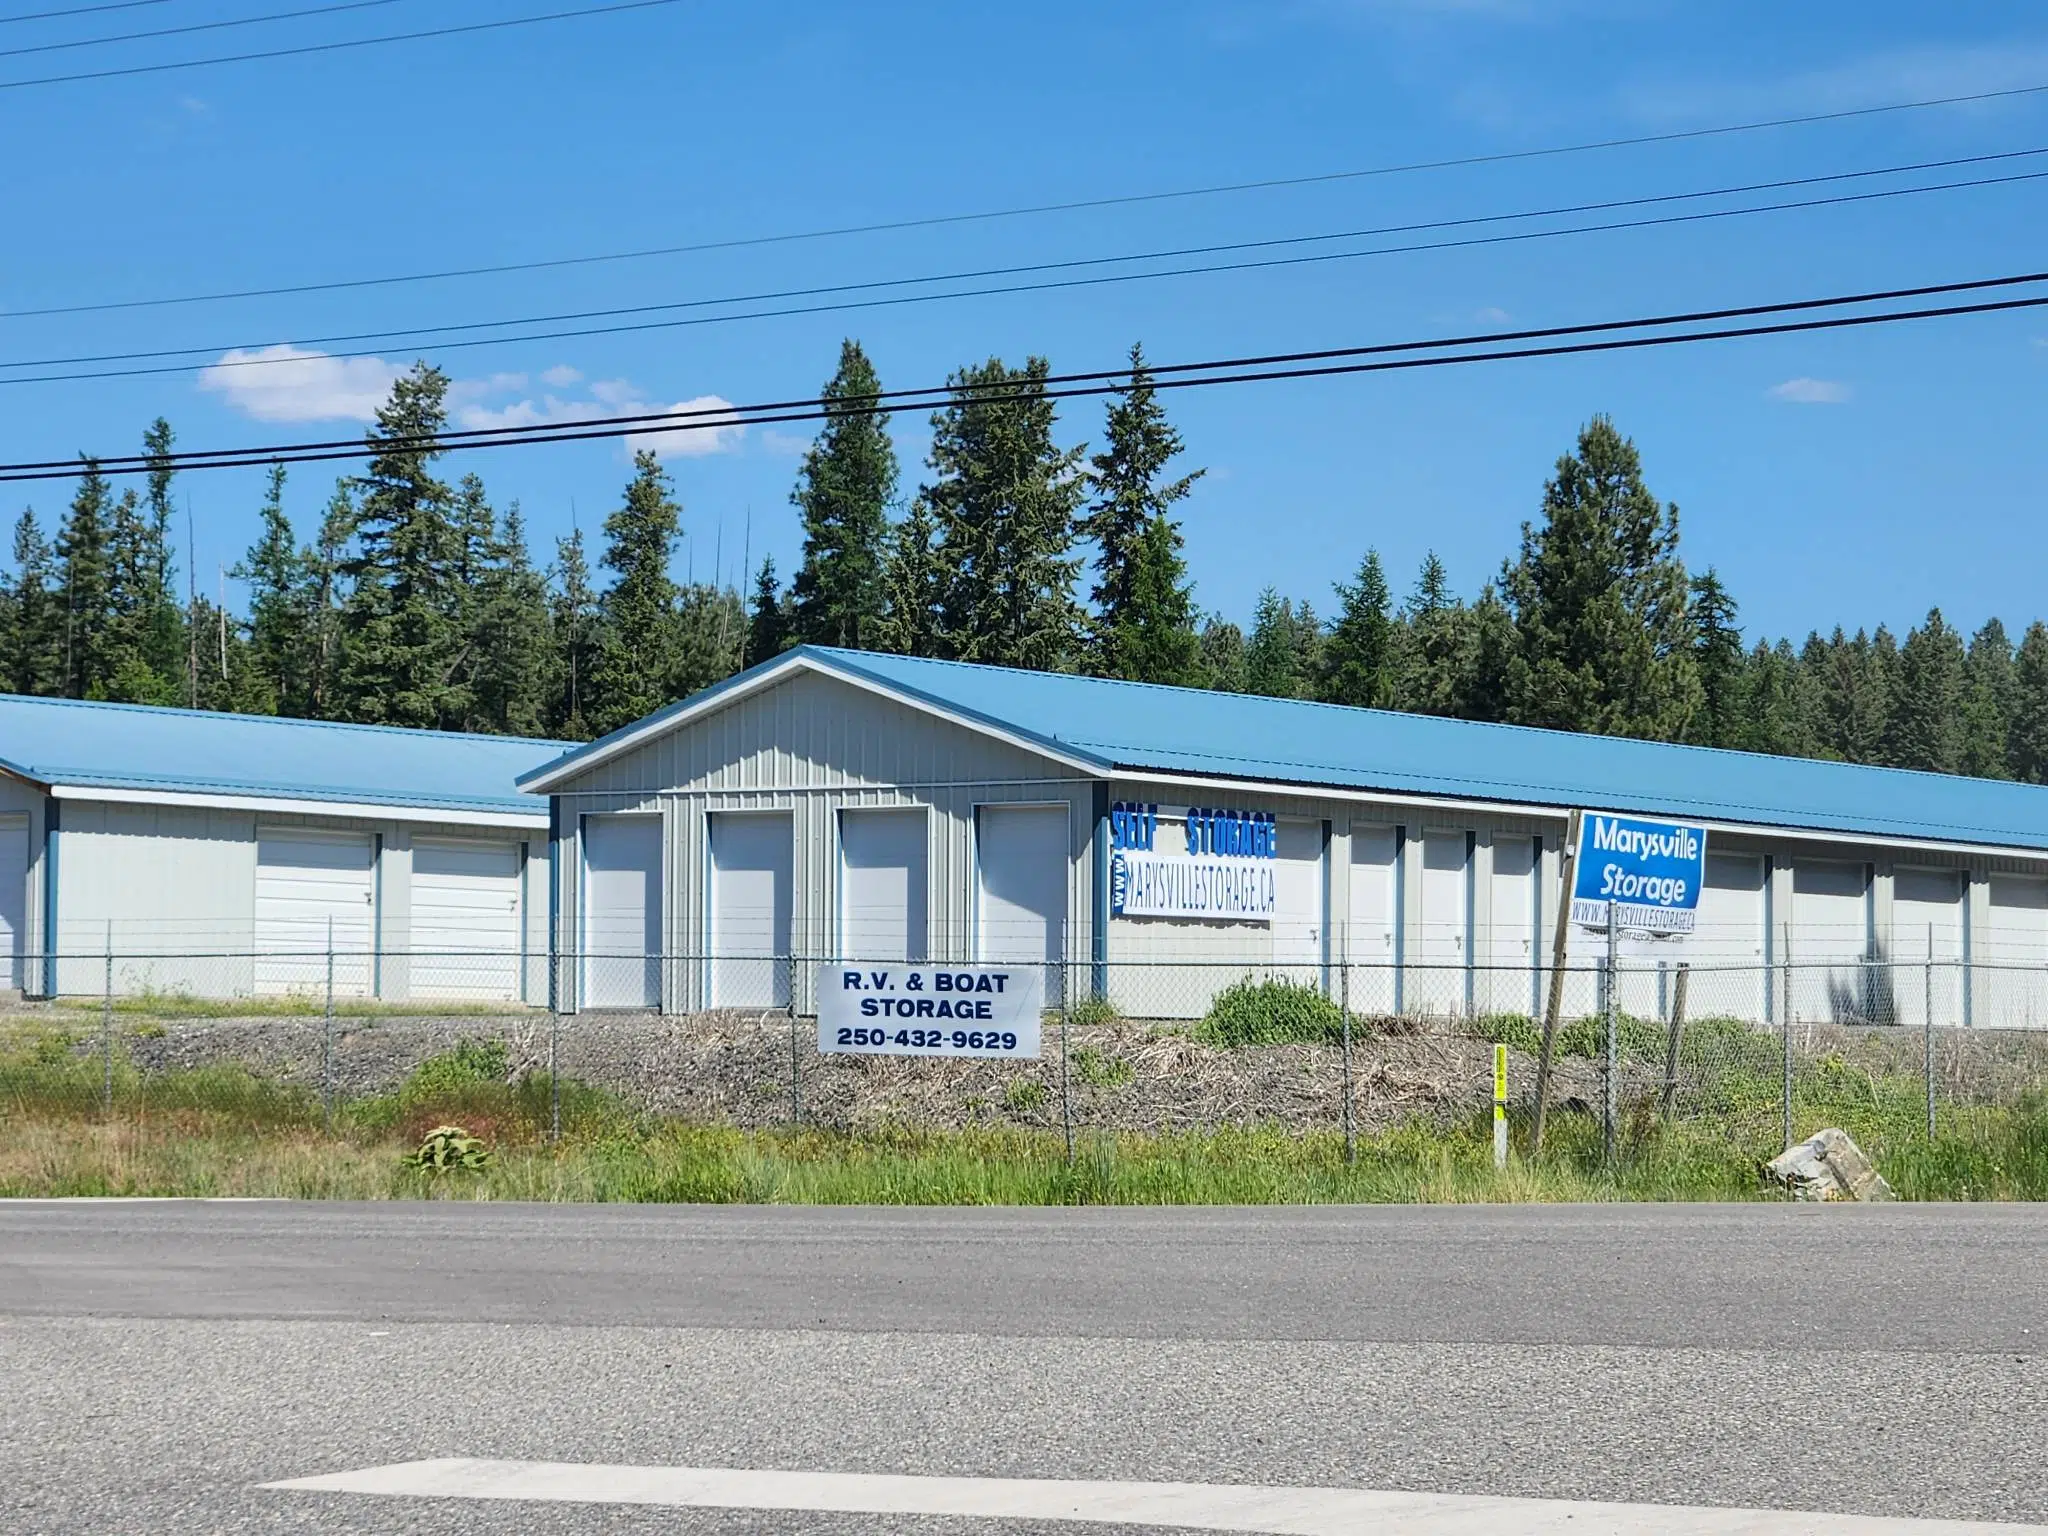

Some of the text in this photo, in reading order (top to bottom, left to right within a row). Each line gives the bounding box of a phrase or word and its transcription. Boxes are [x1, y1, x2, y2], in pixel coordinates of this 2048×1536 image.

[1112, 801, 1277, 860] SELF STORAGE
[1594, 817, 1698, 861] Marysville
[1600, 863, 1687, 906] Storage
[843, 971, 1009, 993] R.V. & BOAT
[860, 998, 993, 1020] STORAGE
[837, 1027, 1017, 1050] 250-432-9629
